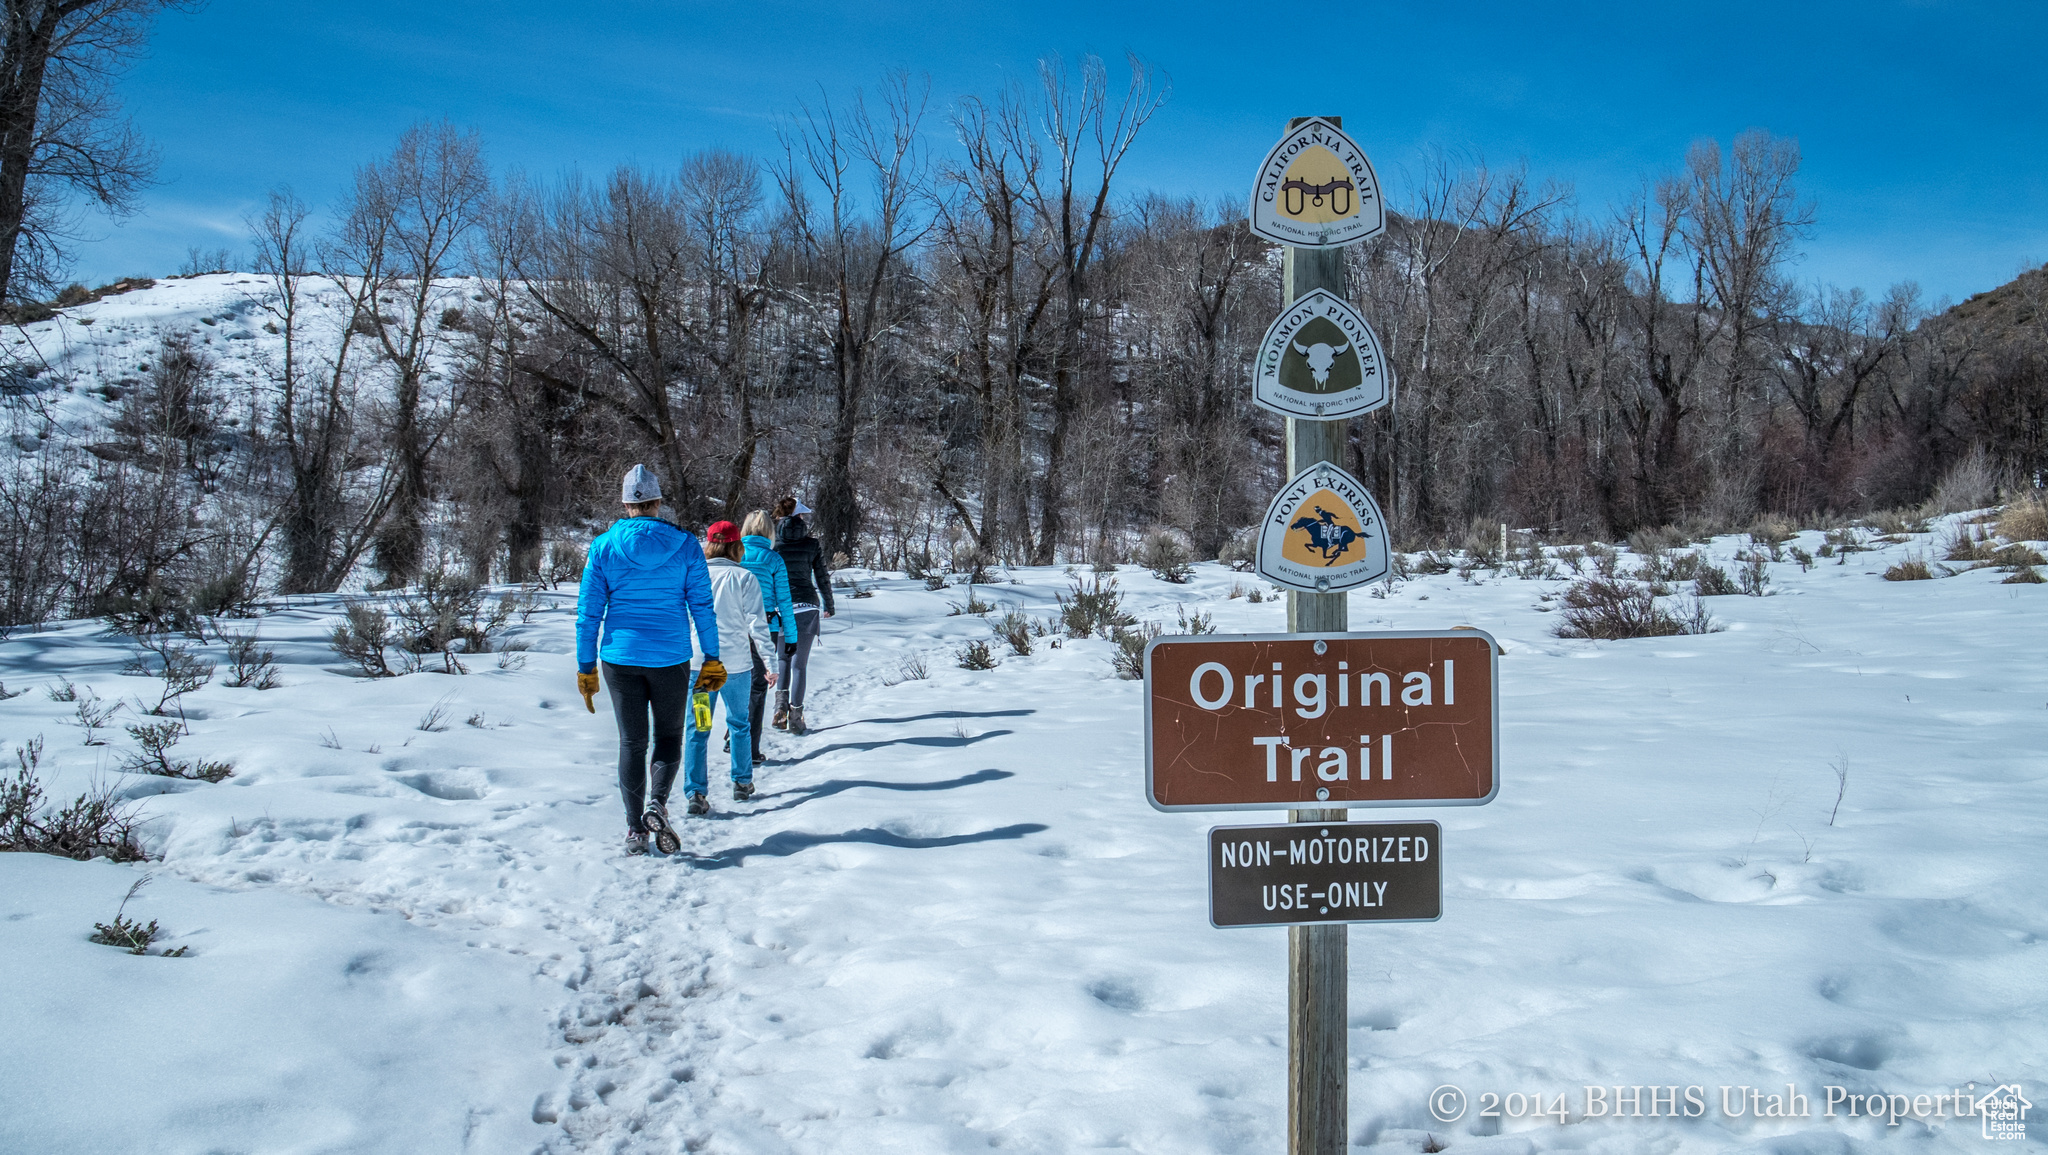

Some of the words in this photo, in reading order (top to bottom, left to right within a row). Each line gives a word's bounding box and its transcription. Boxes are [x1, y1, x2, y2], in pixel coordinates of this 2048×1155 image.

[1263, 133, 1341, 202] CALIFORNIA
[1345, 152, 1373, 204] TRAIL
[1271, 221, 1305, 236] NATIONAL
[1308, 228, 1341, 237] HISTORIC
[1343, 222, 1363, 233] TRAIL
[1264, 306, 1315, 378] MORMON
[1326, 306, 1376, 378] PIONEER
[1274, 392, 1307, 407] NATIONAL
[1310, 399, 1343, 408] HISTORIC
[1345, 394, 1365, 404] TRAIL
[1275, 484, 1308, 526] PONY
[1313, 477, 1374, 527] EXPRESS
[1277, 565, 1311, 580] NATIONAL
[1349, 566, 1369, 577] TRAIL
[1189, 659, 1454, 719] Original
[1253, 734, 1393, 783] Trail
[1221, 836, 1429, 868] NON-MOTORIZED
[1263, 881, 1388, 911] USE-ONLY
